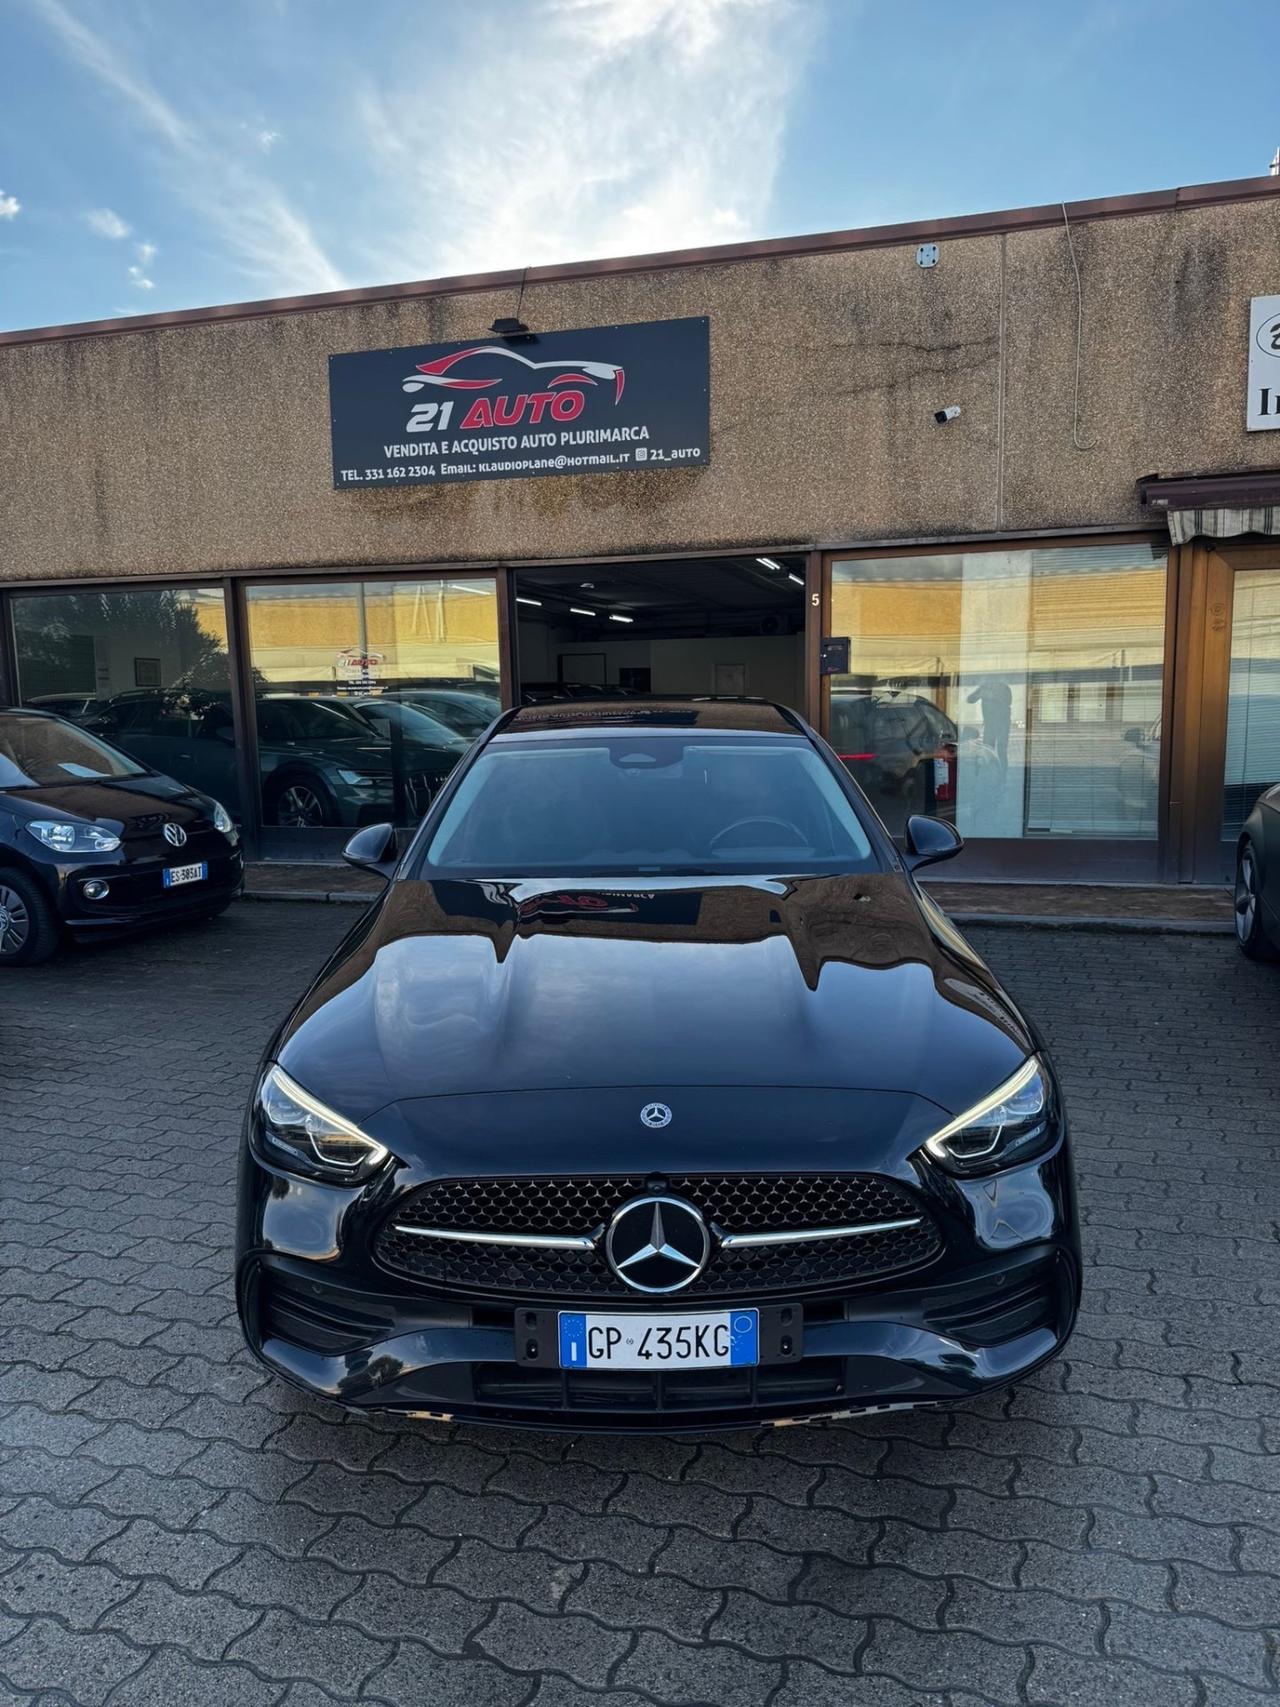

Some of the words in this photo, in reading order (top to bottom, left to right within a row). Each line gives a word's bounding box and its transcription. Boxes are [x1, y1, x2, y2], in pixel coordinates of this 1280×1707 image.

[406, 401, 454, 433] 21
[460, 390, 585, 429] AUTO
[384, 442, 439, 459] VENDITA
[442, 441, 449, 454] E
[451, 436, 517, 455] ACQUISTO
[521, 433, 557, 449] AUTO
[561, 426, 650, 446] PLURIMARCA
[341, 469, 363, 482] TEL.
[365, 468, 385, 480] 331
[387, 466, 406, 479] 162
[408, 465, 436, 477] 2304
[812, 593, 820, 607] 5
[171, 870, 180, 883] ES
[588, 1326, 622, 1360] GP
[637, 1324, 730, 1360] 435KG
